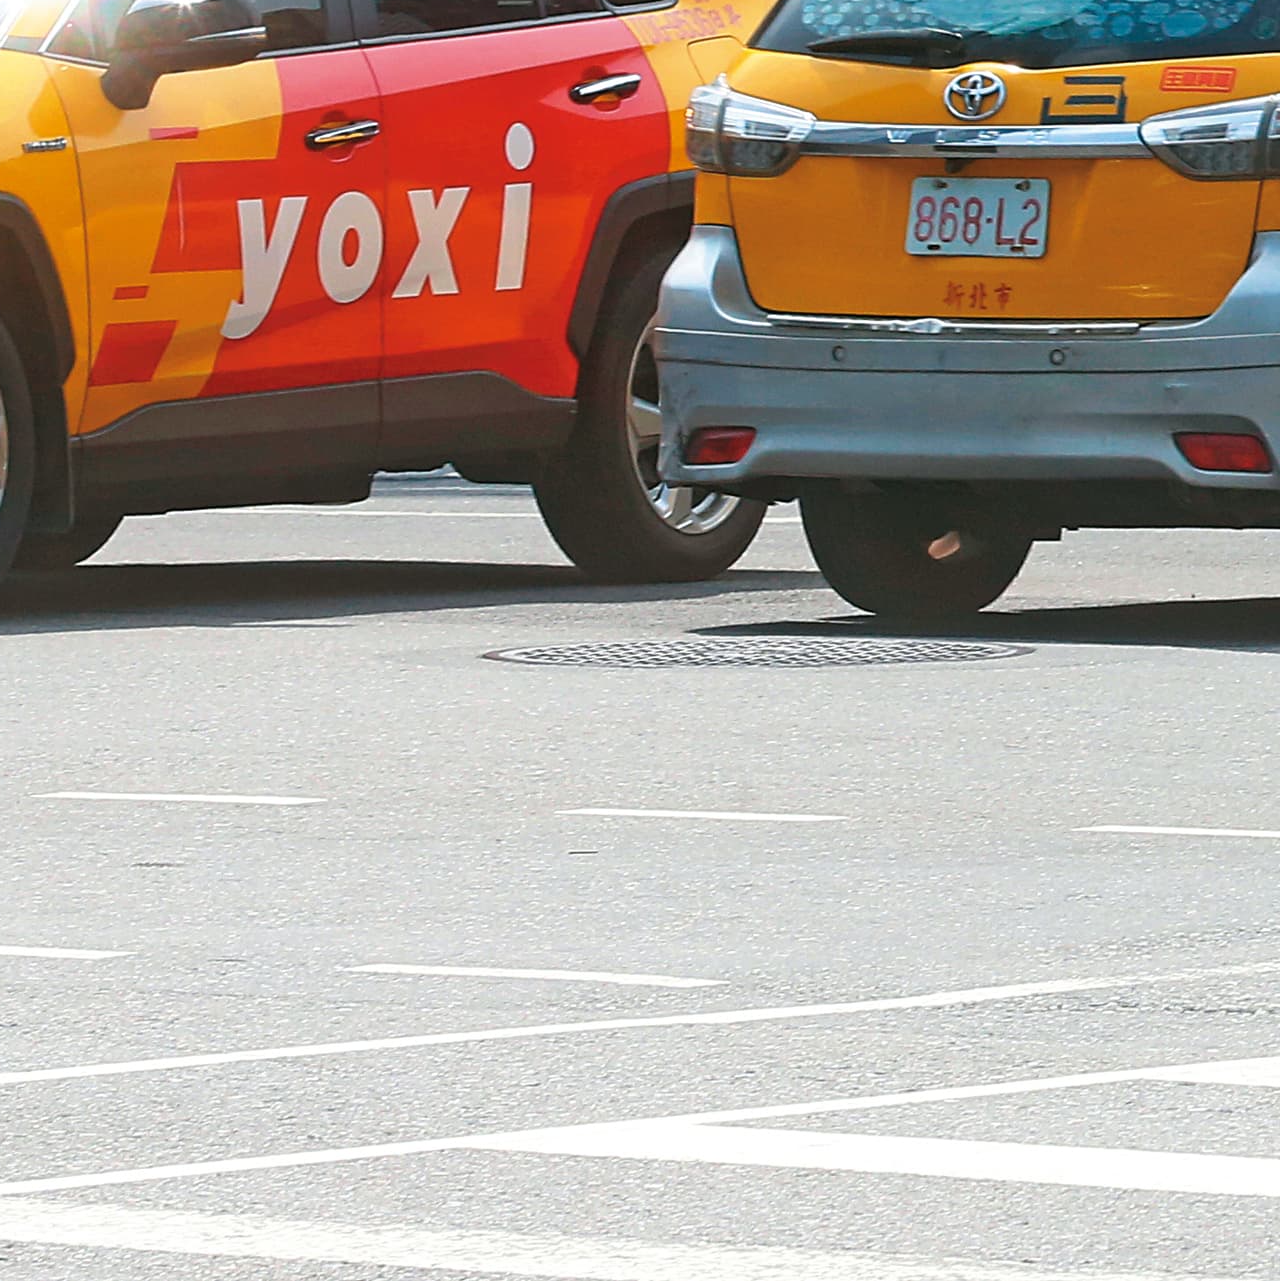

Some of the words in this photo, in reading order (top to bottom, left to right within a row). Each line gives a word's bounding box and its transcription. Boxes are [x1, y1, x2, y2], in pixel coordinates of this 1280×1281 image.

[220, 121, 535, 340] yoxi
[942, 280, 1013, 310] 新北市
